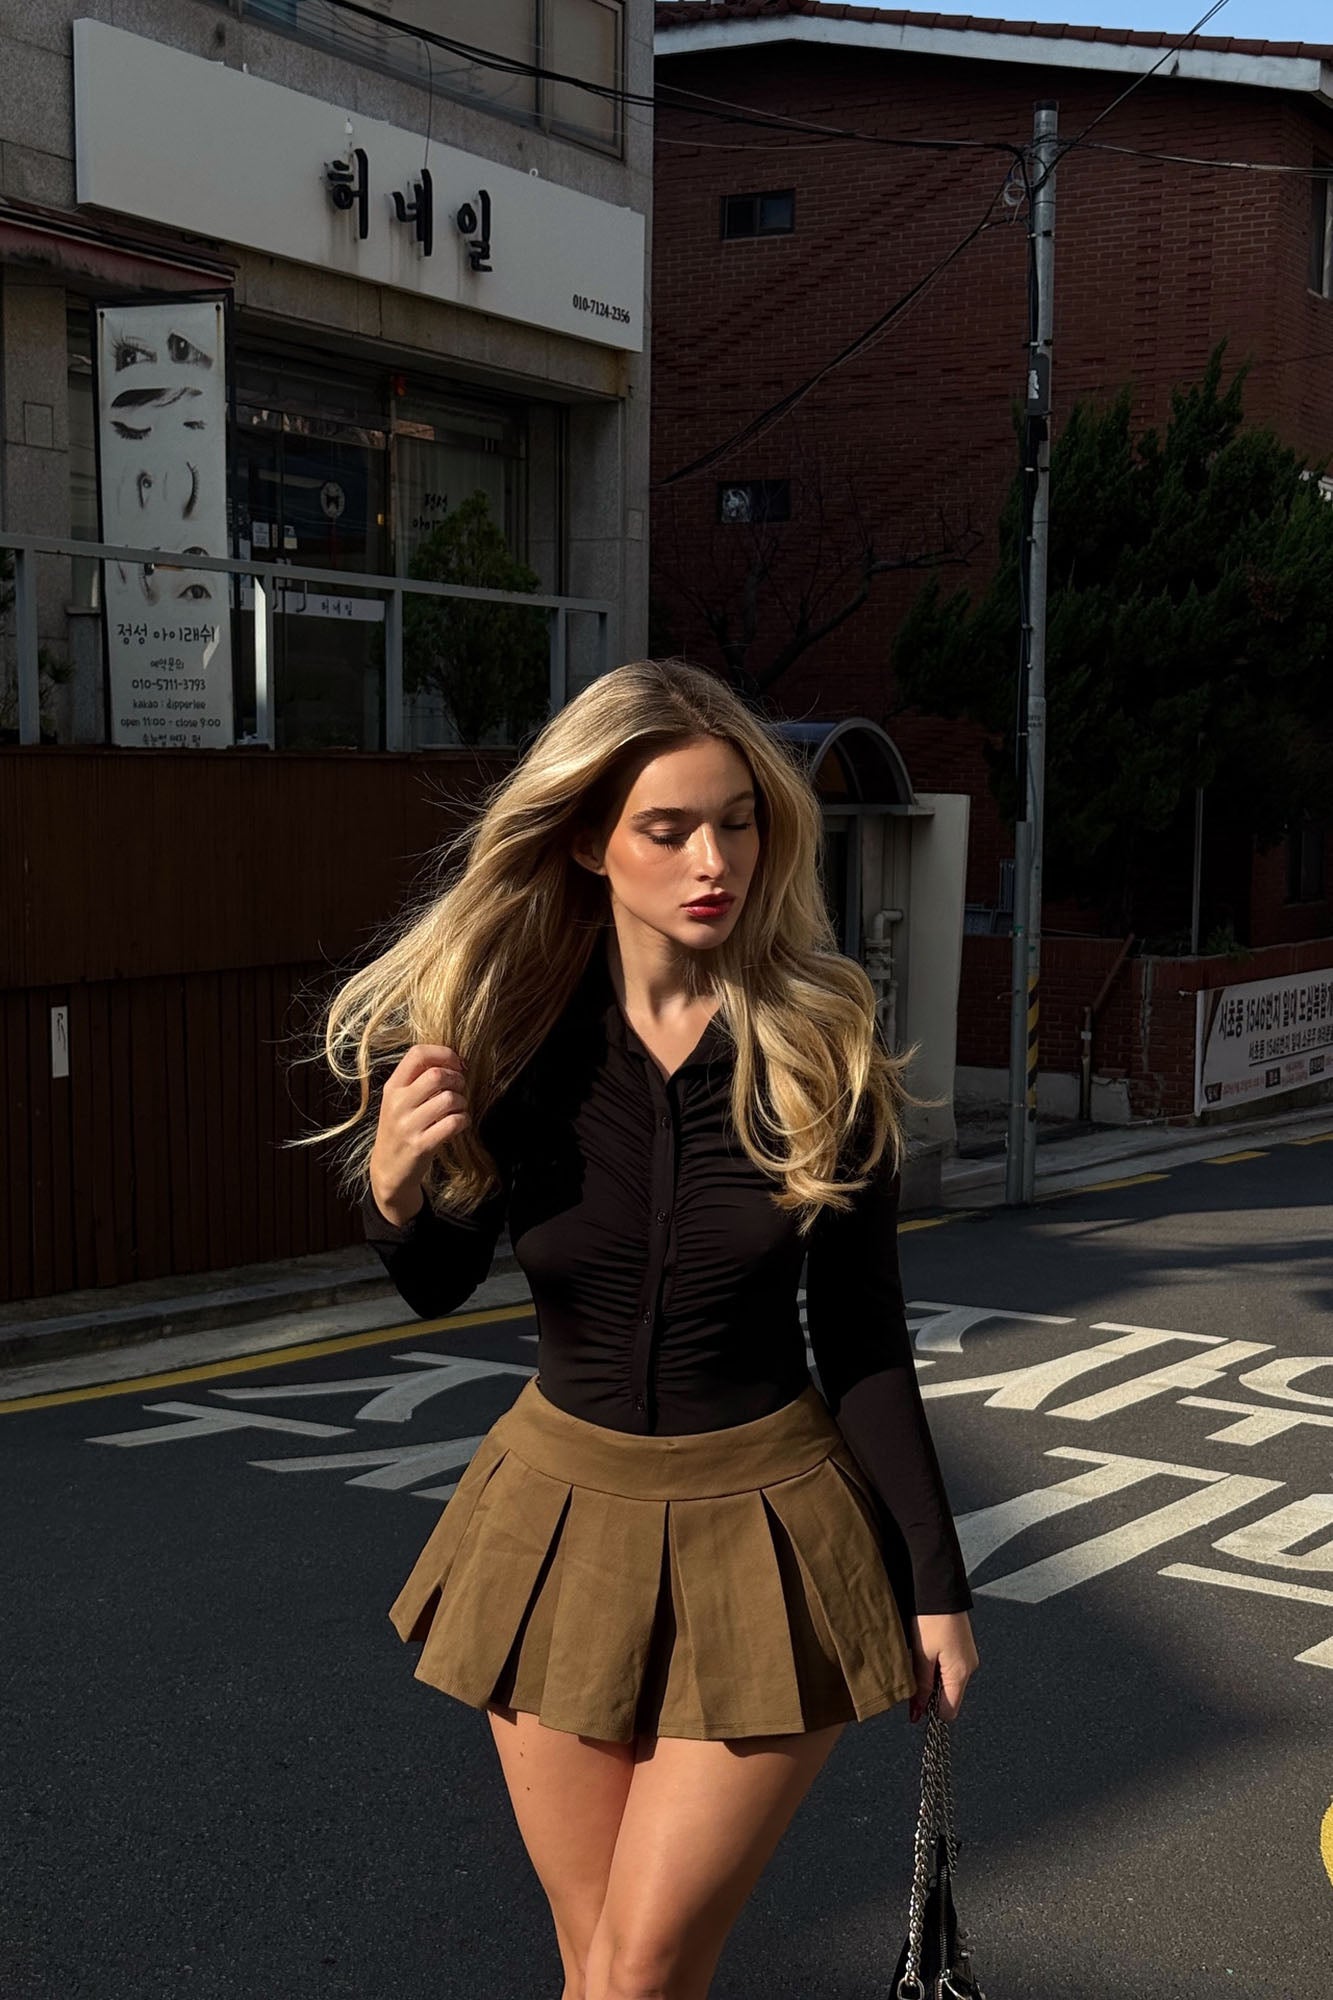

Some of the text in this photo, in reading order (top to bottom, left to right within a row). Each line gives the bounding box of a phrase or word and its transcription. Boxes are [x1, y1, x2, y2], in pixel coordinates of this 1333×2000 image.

[327, 148, 492, 272] 허네일
[572, 293, 631, 324] 010-7124-2356
[117, 623, 215, 645] 정성 아이래쉬
[150, 657, 184, 671] 예약문의
[132, 679, 206, 691] 010-5711-3793
[133, 699, 159, 709] kakao
[121, 719, 140, 728] open
[142, 717, 166, 727] 11:00
[175, 718, 198, 728] close
[1218, 999, 1244, 1040] 서초동
